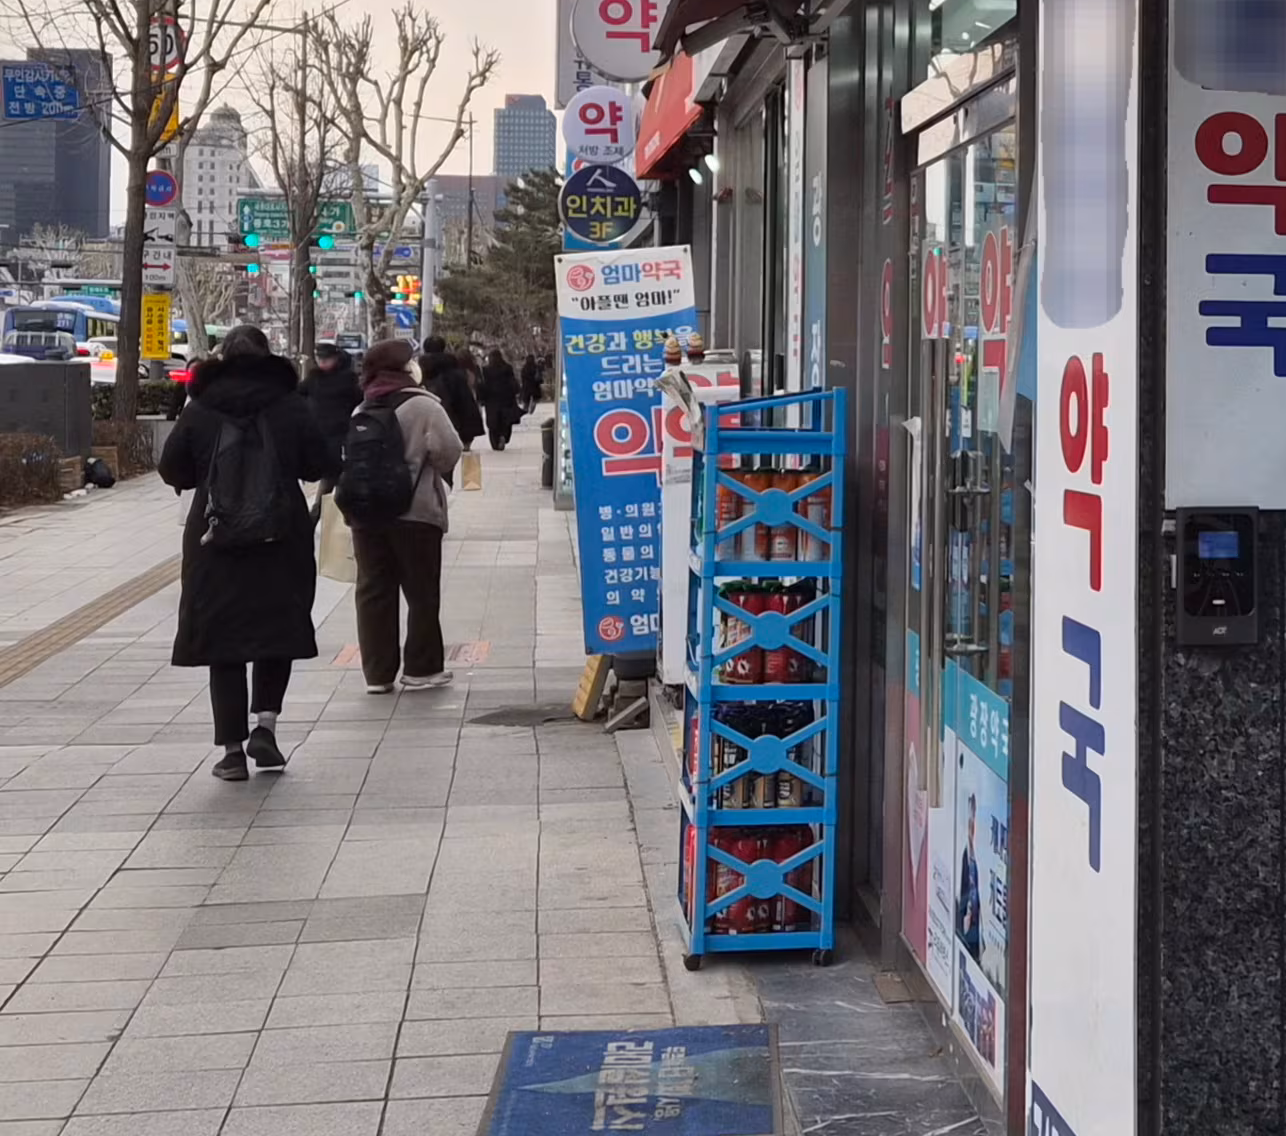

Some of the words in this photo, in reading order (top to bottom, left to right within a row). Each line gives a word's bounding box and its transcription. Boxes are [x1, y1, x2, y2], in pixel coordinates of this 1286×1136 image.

[578, 101, 623, 144] 약
[566, 194, 637, 219] 인치과
[589, 222, 616, 239] 3F
[600, 260, 682, 286] 엄마약국
[565, 331, 627, 355] 건강과
[601, 353, 662, 376] 드리는
[591, 376, 660, 401] 엄마약
[601, 523, 662, 541] 일반의
[1059, 351, 1110, 873] 약국
